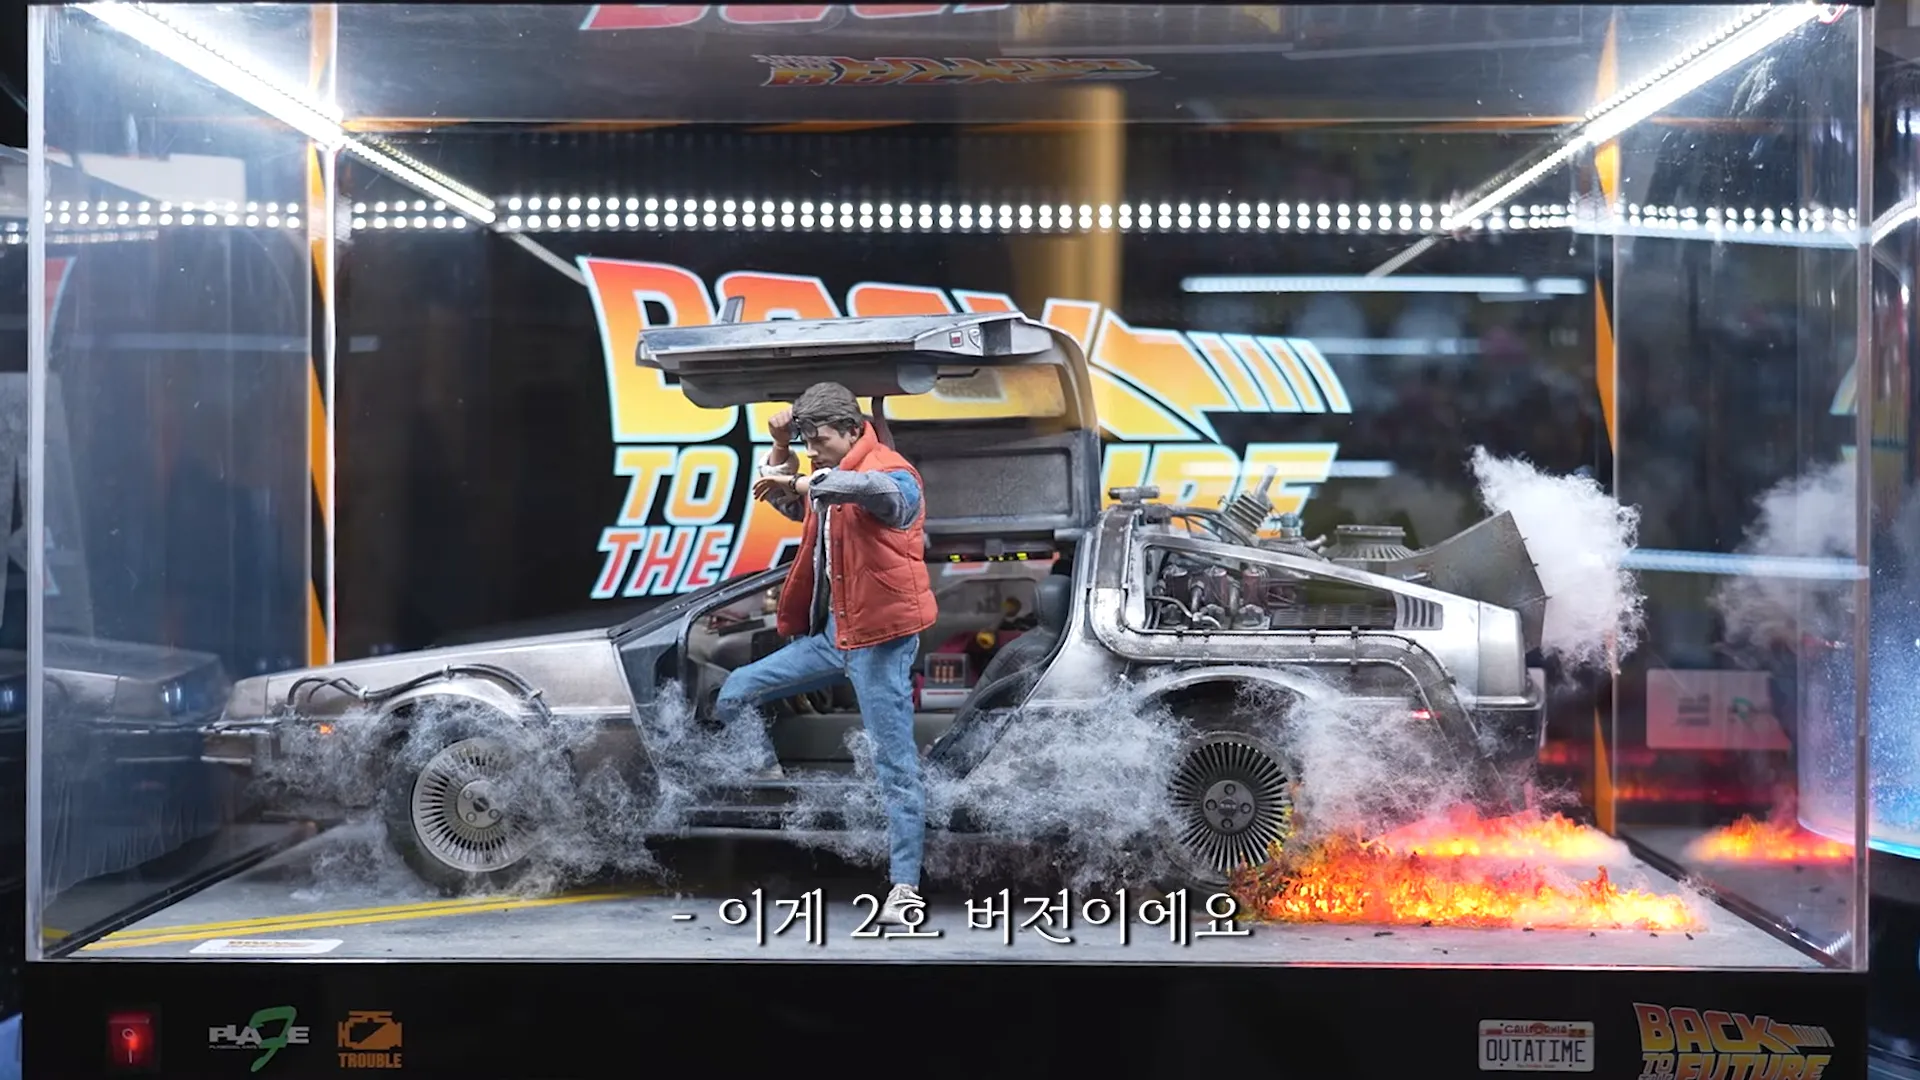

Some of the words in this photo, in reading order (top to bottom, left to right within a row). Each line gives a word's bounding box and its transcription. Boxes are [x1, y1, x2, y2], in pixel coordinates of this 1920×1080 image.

[613, 443, 739, 527] TO
[590, 523, 735, 599] THE
[1633, 1003, 1800, 1053] BACK
[338, 1053, 402, 1069] TROUBLE
[1486, 1039, 1586, 1063] OUTATIME
[1642, 1053, 1675, 1074] TO
